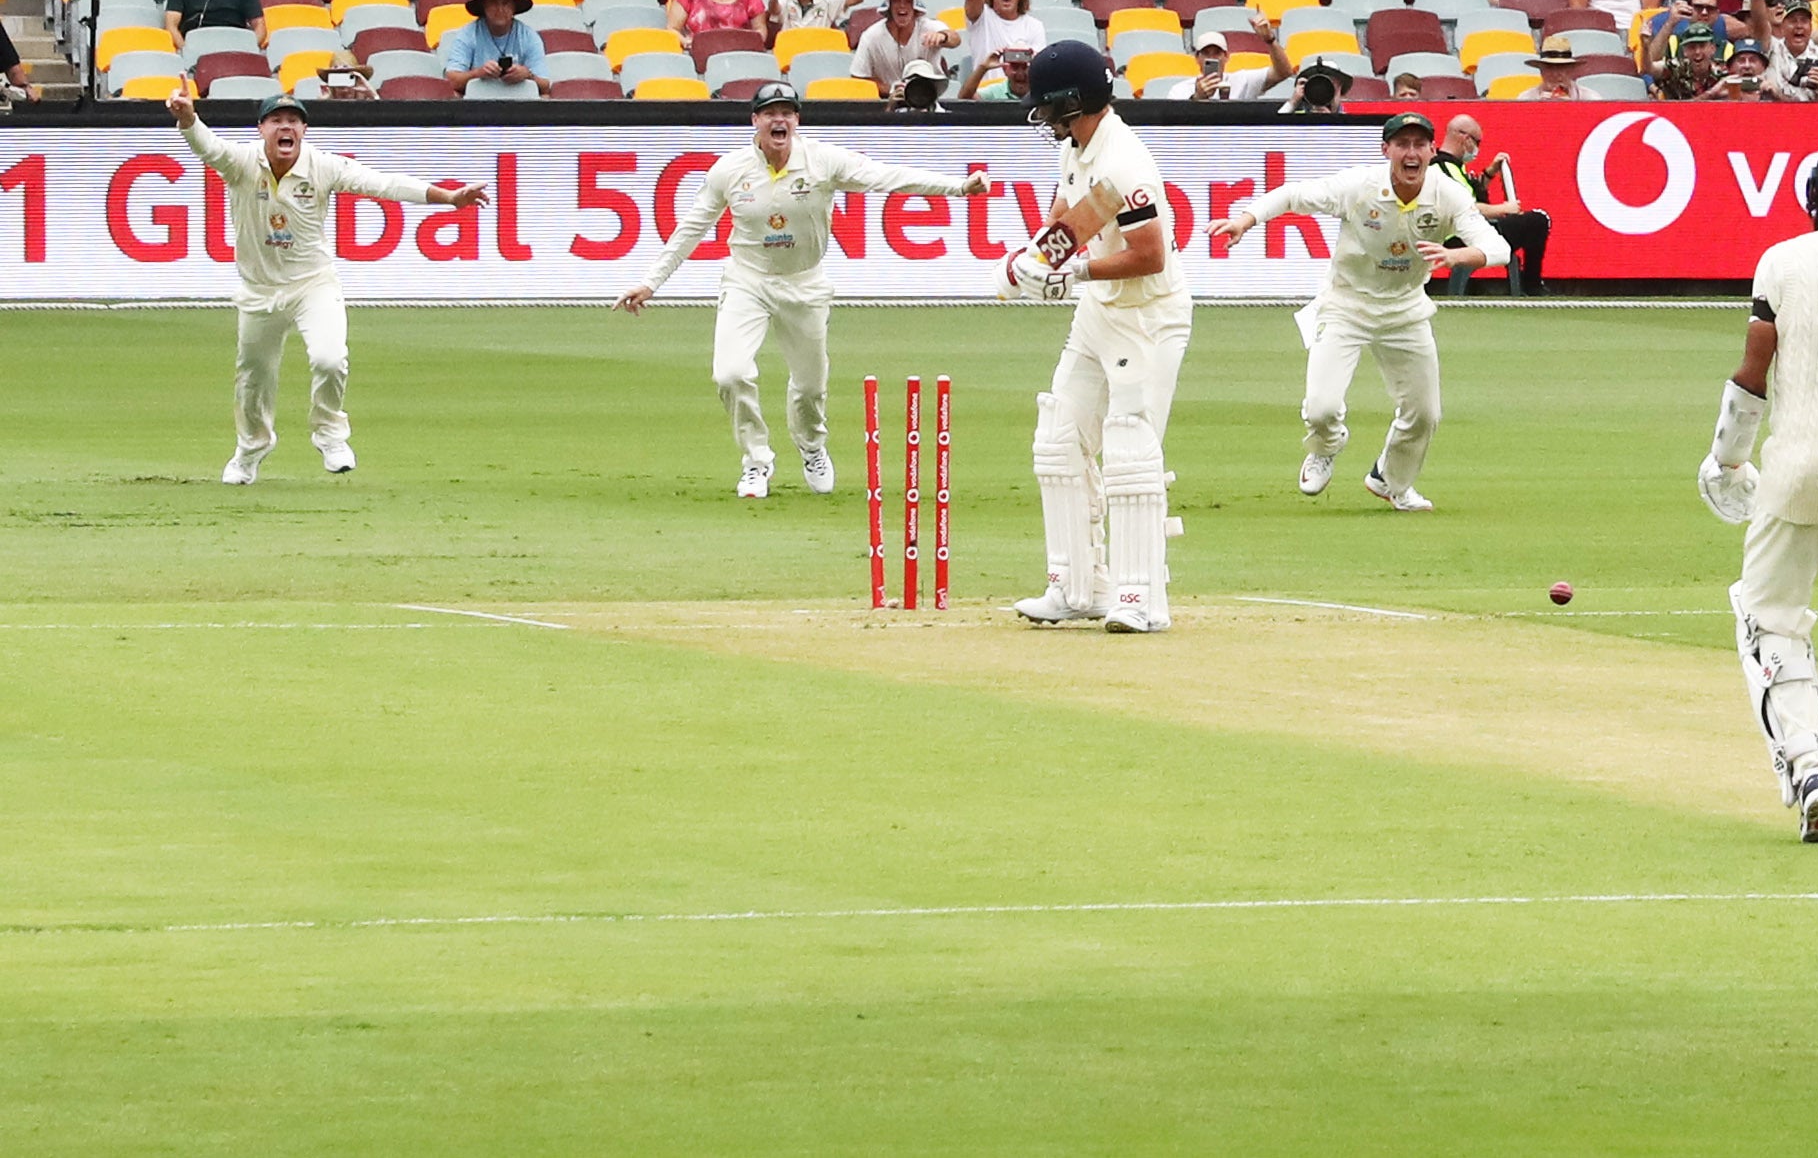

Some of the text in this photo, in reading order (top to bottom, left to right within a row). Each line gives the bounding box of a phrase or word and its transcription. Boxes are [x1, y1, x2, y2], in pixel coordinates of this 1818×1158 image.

[0, 154, 46, 263] 1
[107, 153, 532, 262] Glbal
[1124, 188, 1150, 212] IG
[1041, 228, 1073, 264] DSC
[908, 507, 917, 546] odafone
[1120, 593, 1141, 604] DSC
